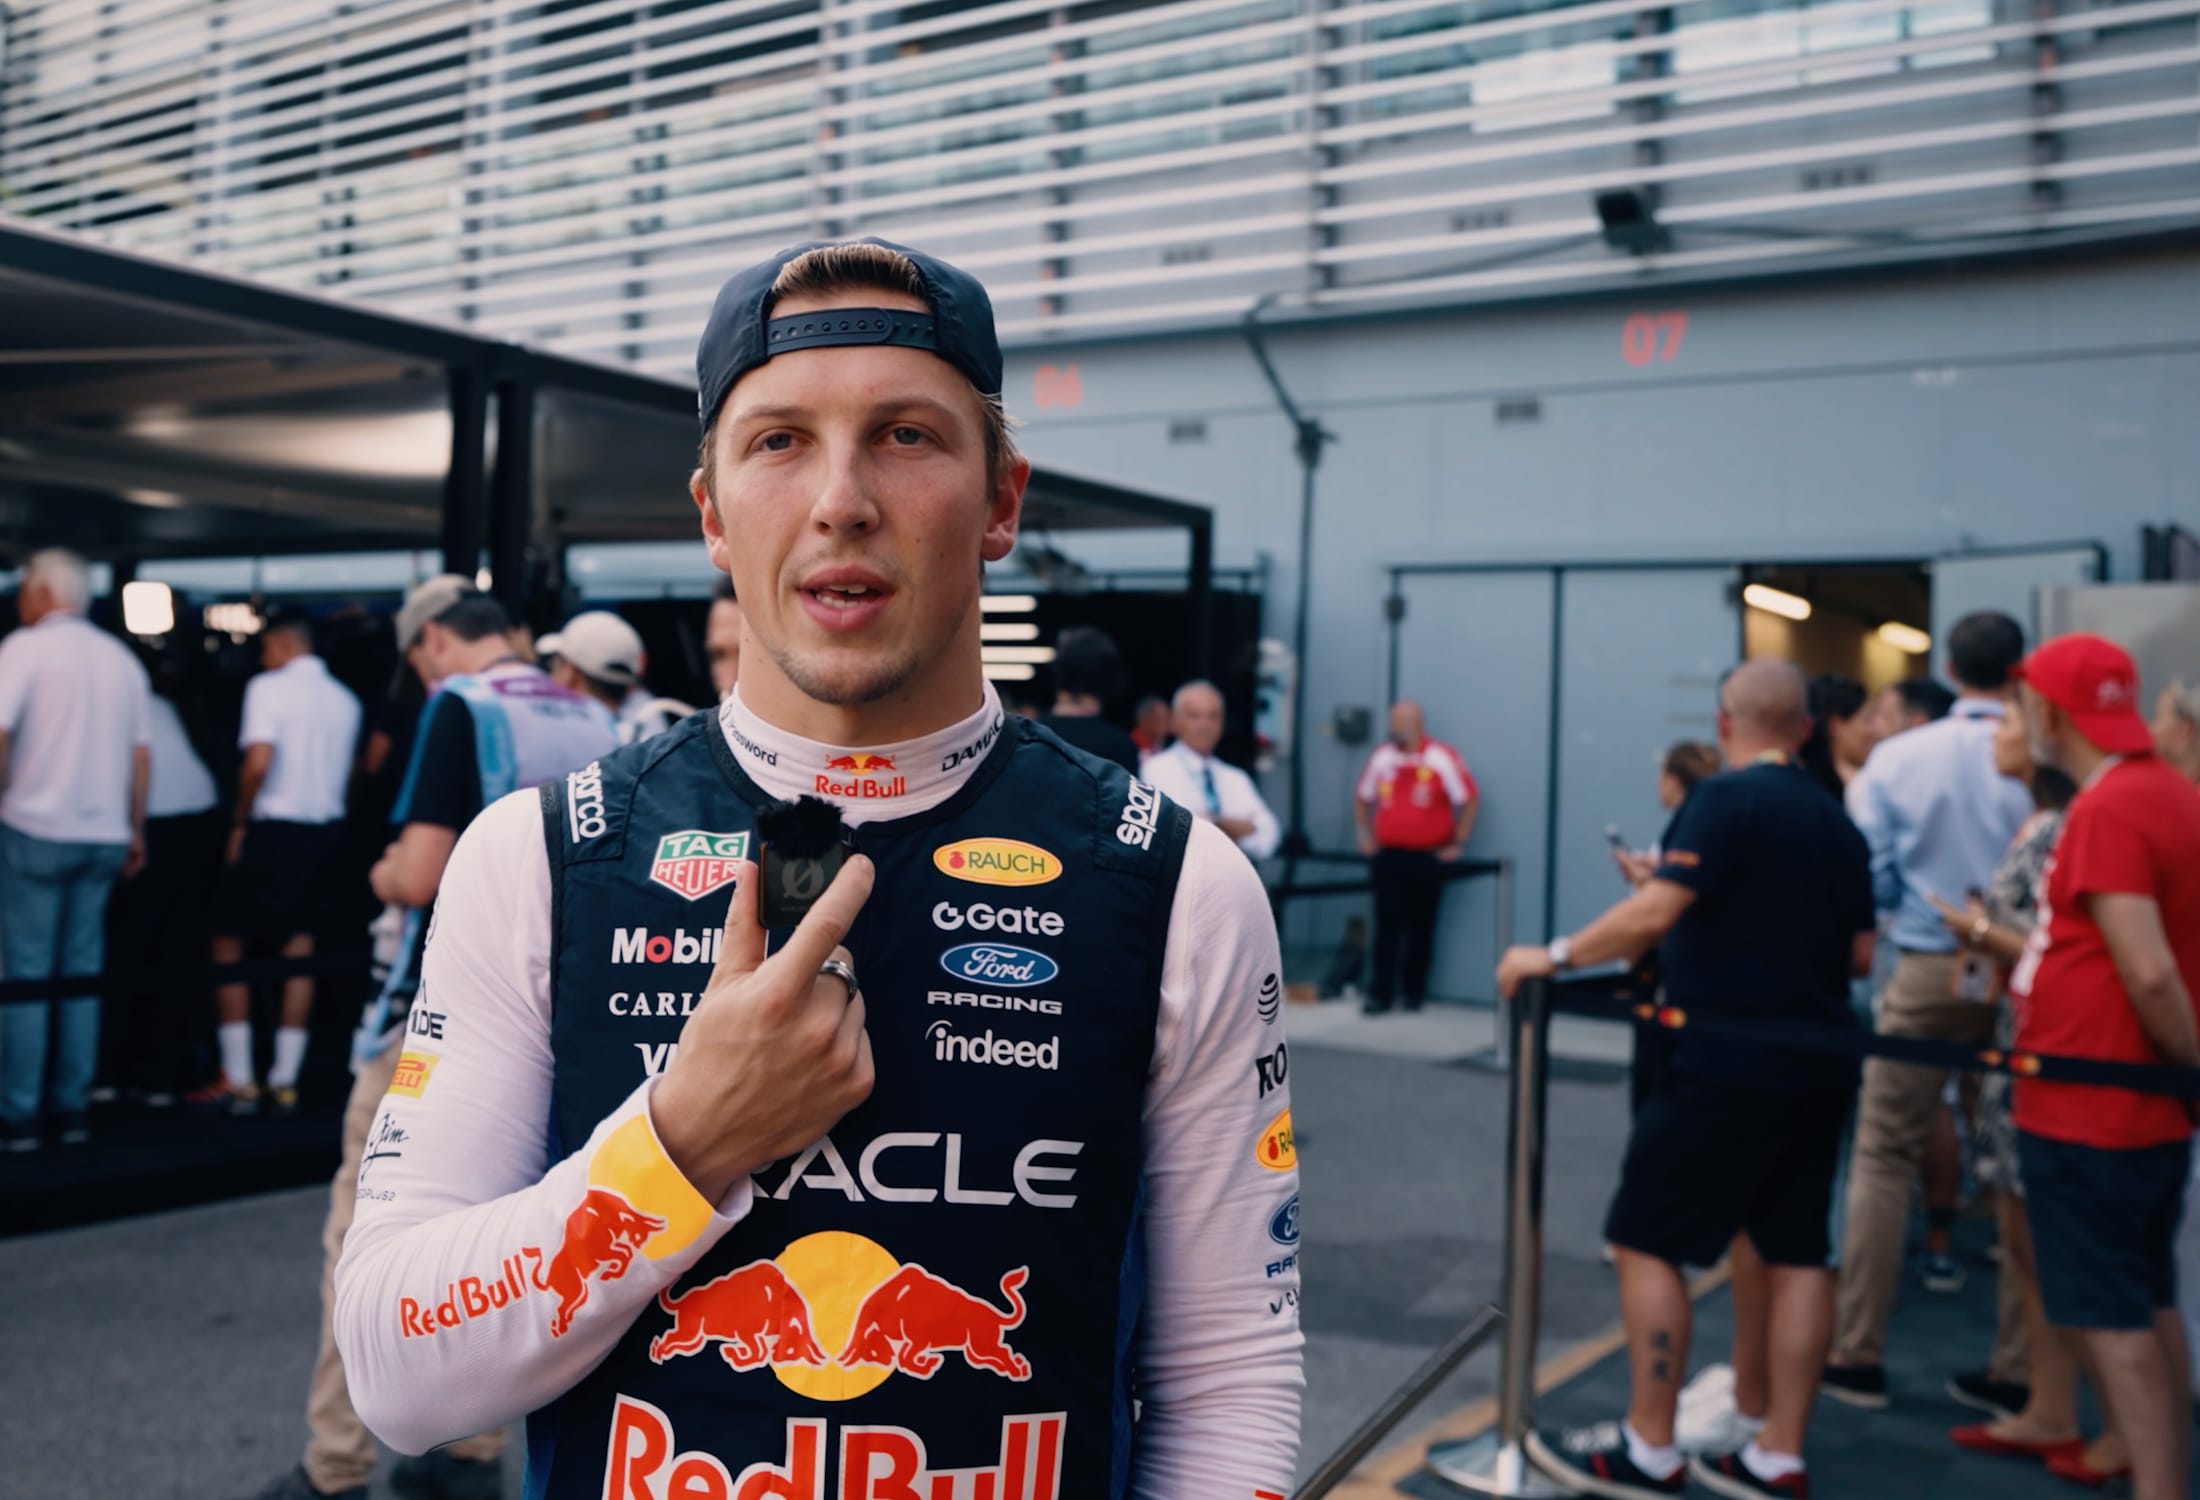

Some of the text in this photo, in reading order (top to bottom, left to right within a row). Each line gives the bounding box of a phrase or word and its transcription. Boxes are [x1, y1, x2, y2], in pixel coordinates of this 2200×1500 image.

[1621, 312, 1688, 366] 07
[816, 775, 905, 798] Red Bull
[667, 835, 740, 857] TAG
[969, 851, 1045, 874] RAUCH
[611, 927, 724, 964] Mobil
[964, 947, 1036, 981] Ford
[608, 992, 704, 1016] CARL
[927, 991, 1062, 1016] RACING
[935, 1027, 1060, 1071] indeed
[752, 1132, 1085, 1208] ACLE
[400, 1254, 527, 1338] Red Bull
